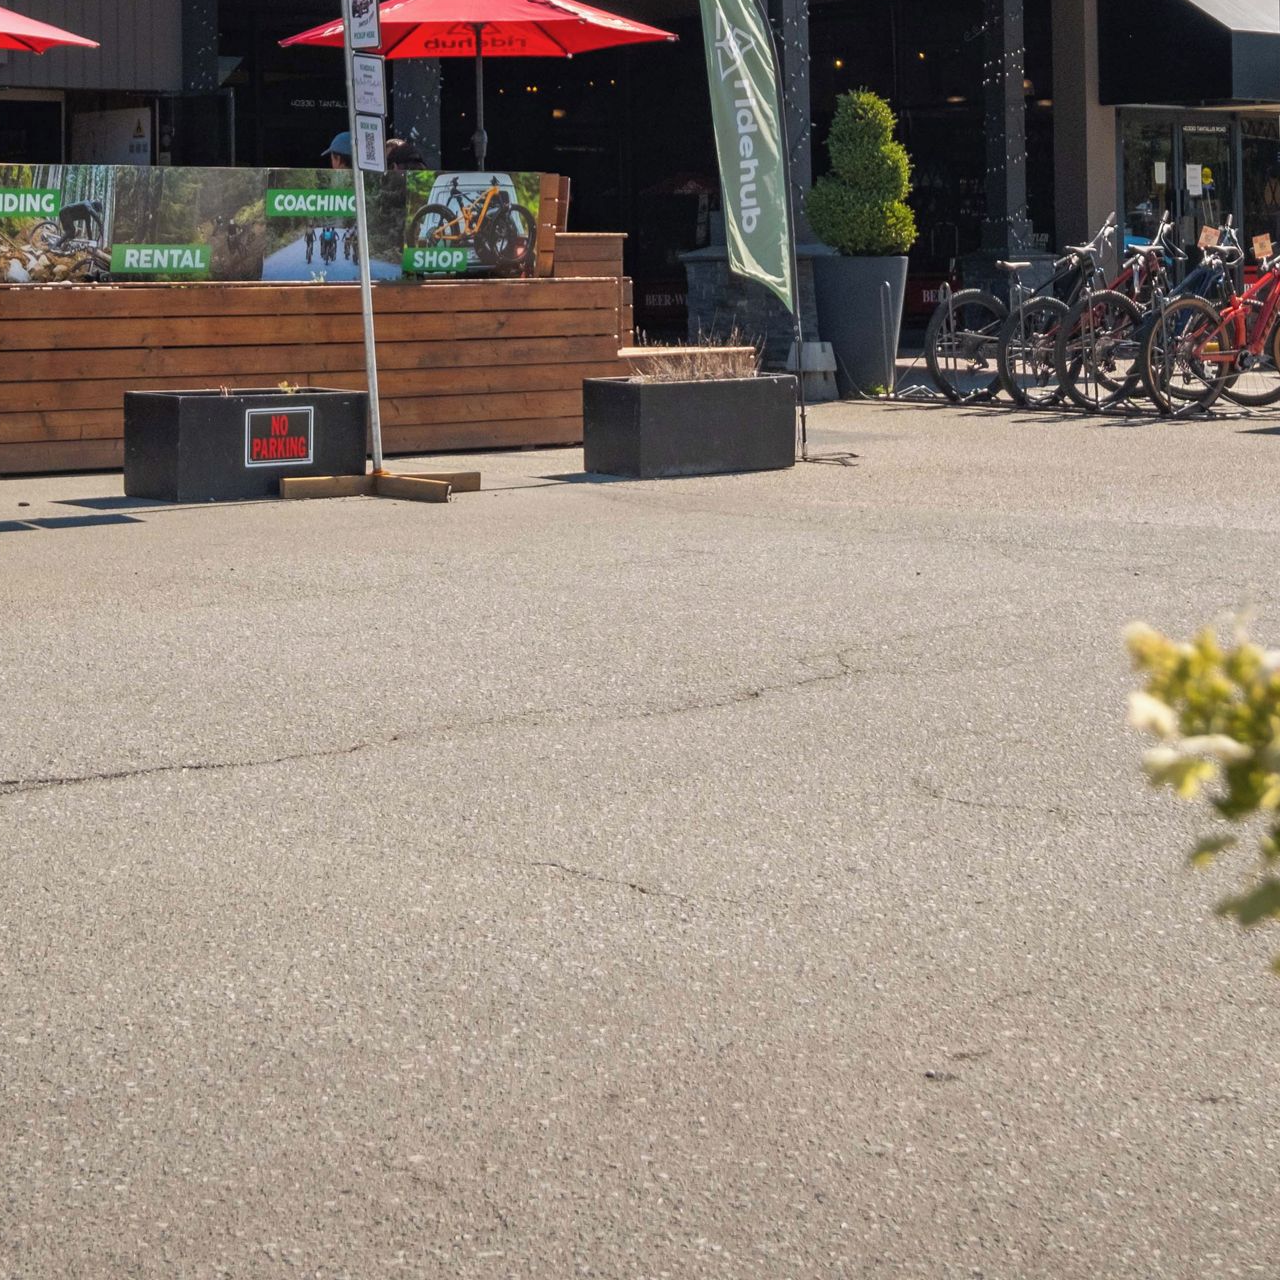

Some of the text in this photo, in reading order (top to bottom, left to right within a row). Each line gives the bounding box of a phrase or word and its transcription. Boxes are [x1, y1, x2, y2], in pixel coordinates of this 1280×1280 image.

[124, 248, 205, 269] RENTAL
[413, 250, 464, 269] SHOP
[271, 415, 289, 436] NO
[252, 436, 306, 460] PARKING
